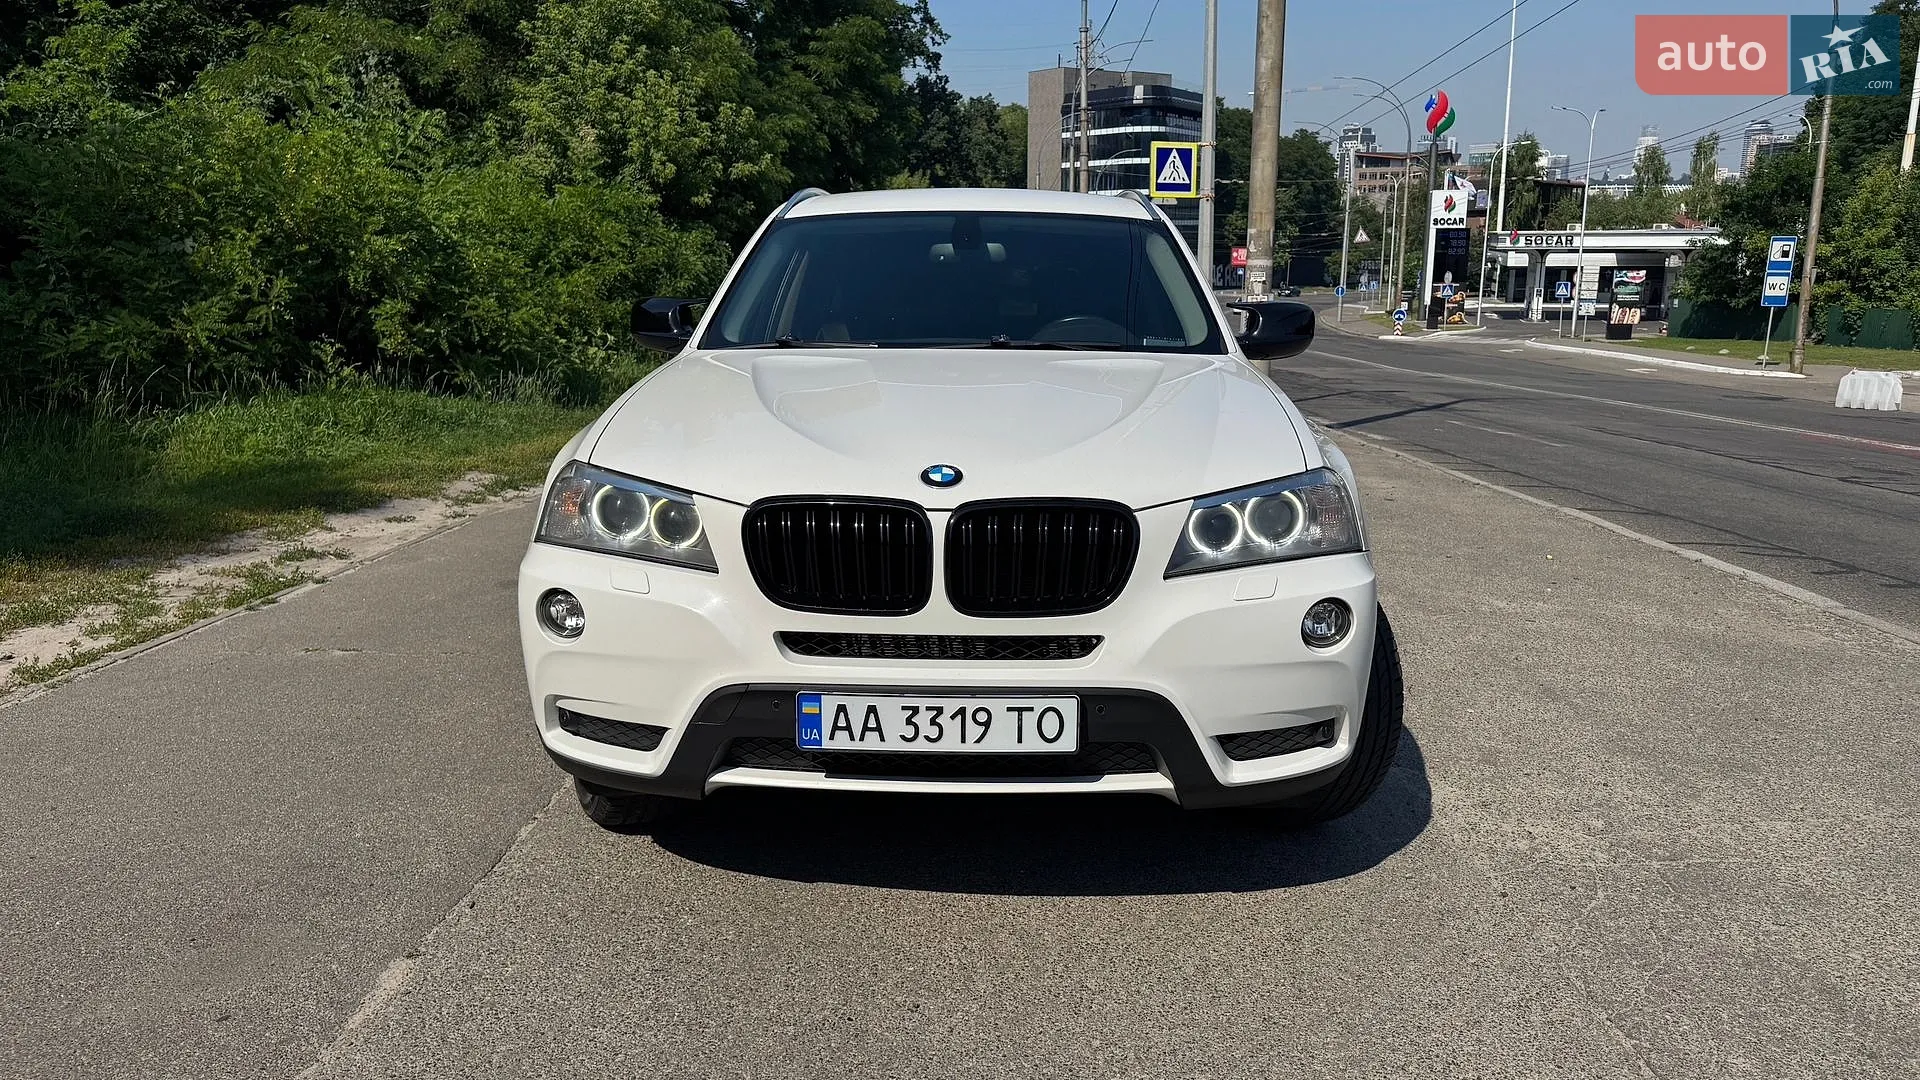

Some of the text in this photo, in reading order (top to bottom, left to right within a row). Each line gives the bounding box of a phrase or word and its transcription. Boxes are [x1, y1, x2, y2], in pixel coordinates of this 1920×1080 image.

[1432, 217, 1465, 226] SOCAR
[1524, 235, 1574, 246] SOCAR
[1768, 282, 1786, 291] WC
[828, 703, 1065, 744] AA 3319 TO
[802, 728, 820, 741] UA
